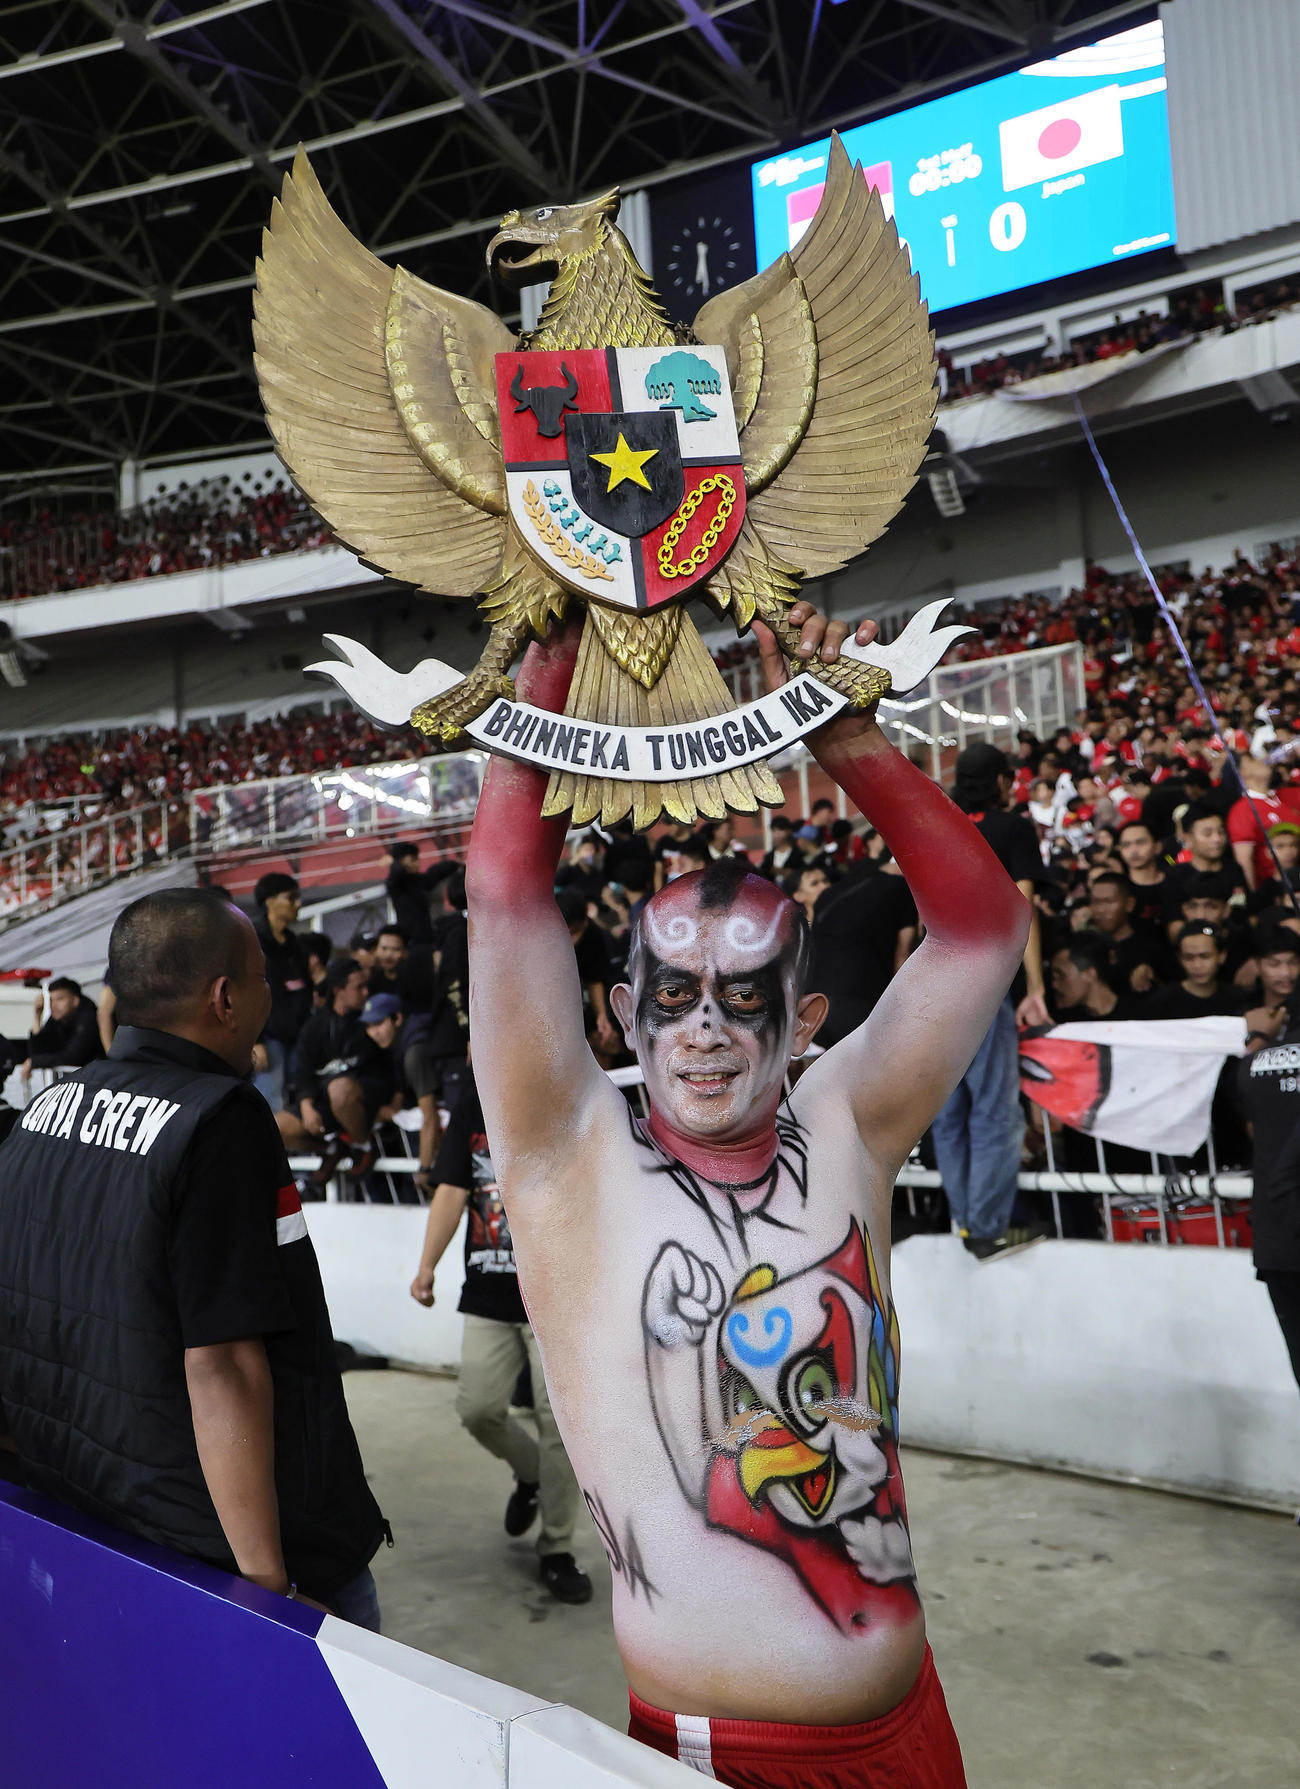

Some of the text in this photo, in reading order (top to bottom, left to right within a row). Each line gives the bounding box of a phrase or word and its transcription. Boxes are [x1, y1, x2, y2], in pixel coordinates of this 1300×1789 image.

[989, 202, 1027, 252] 0
[483, 680, 834, 771] BHINNEKA TUNGGAL IKA
[79, 1088, 182, 1156] CREW
